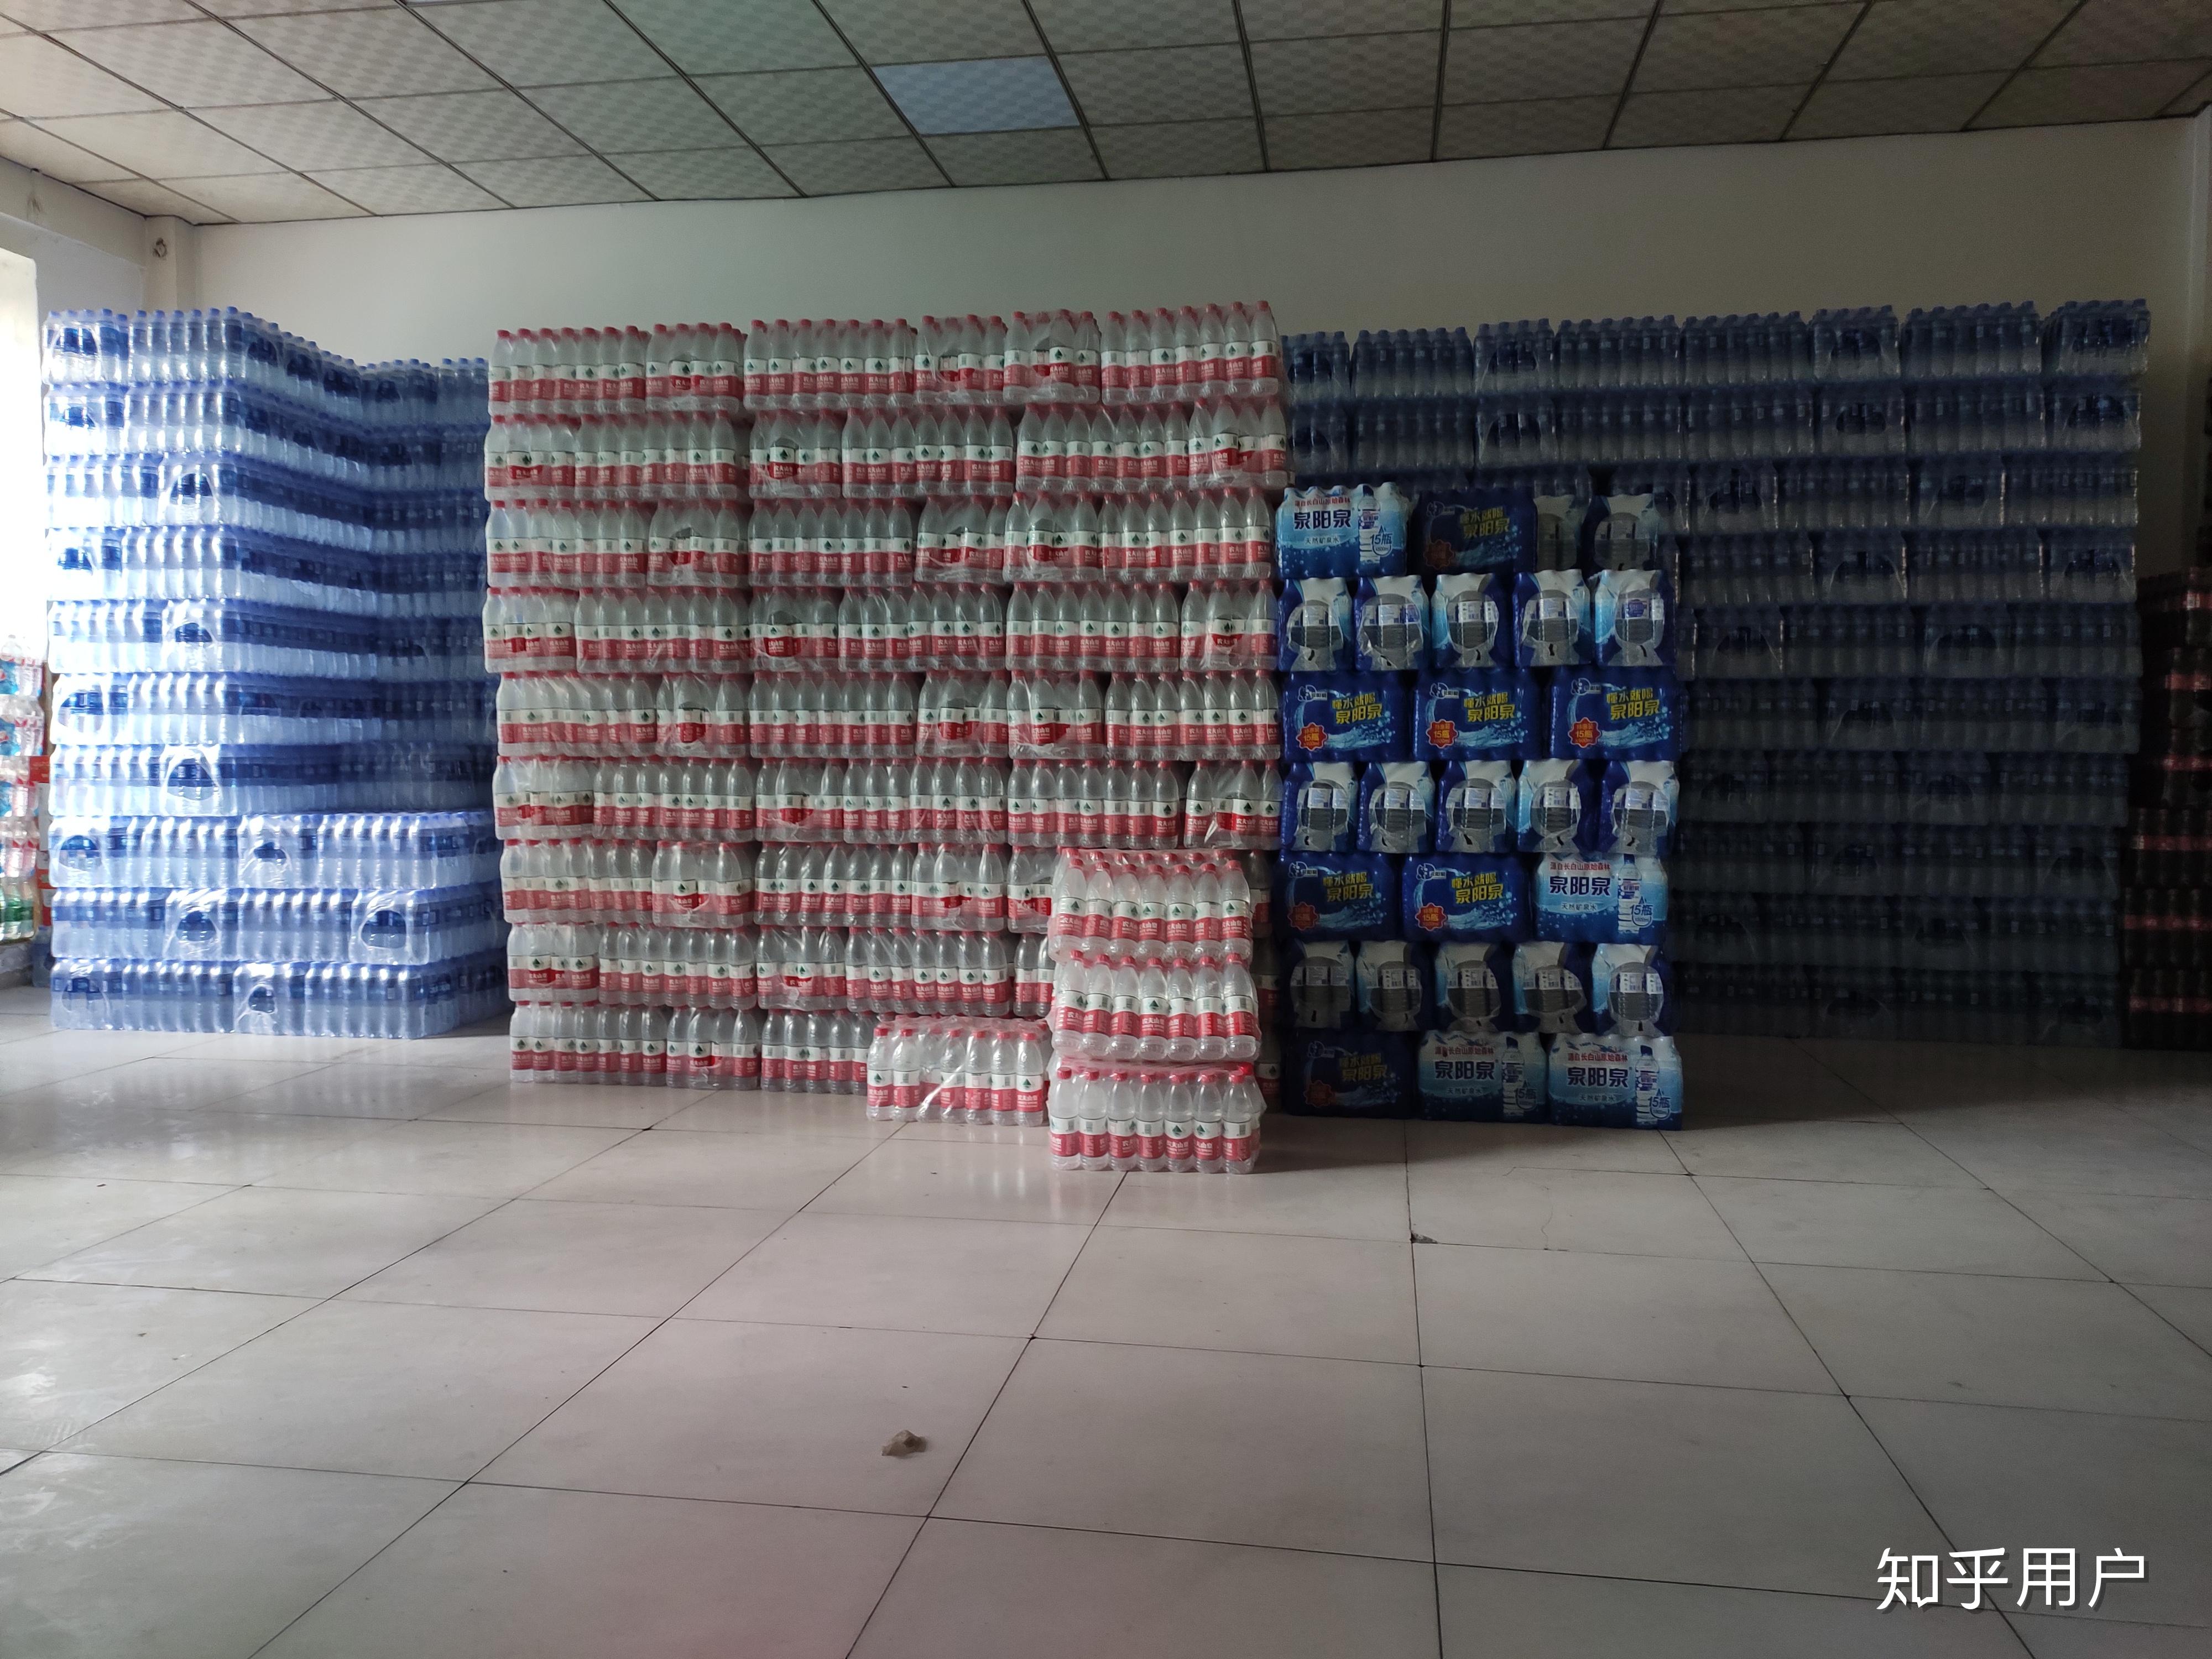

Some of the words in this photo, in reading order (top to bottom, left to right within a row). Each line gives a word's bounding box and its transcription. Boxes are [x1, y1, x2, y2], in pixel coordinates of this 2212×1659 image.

[1294, 510, 1351, 529] 泉阳泉
[1464, 518, 1510, 539] 泉阳泉
[1370, 533, 1392, 545] 15瓶
[1606, 687, 1653, 703] 懂水就喝
[1336, 703, 1382, 724] 泉阳泉
[1467, 704, 1515, 722] 泉阳泉
[1610, 699, 1660, 720] 泉阳泉
[1327, 883, 1374, 902] 泉阳泉
[1455, 883, 1503, 904] 泉阳泉
[1550, 876, 1610, 895] 泉阳泉
[1630, 905, 1653, 915] 15瓶
[1435, 1061, 1494, 1079] 泉阳泉
[1568, 1067, 1628, 1087] 泉阳泉
[1515, 1088, 1536, 1099] 15瓶
[1648, 1097, 1671, 1108] 15瓶
